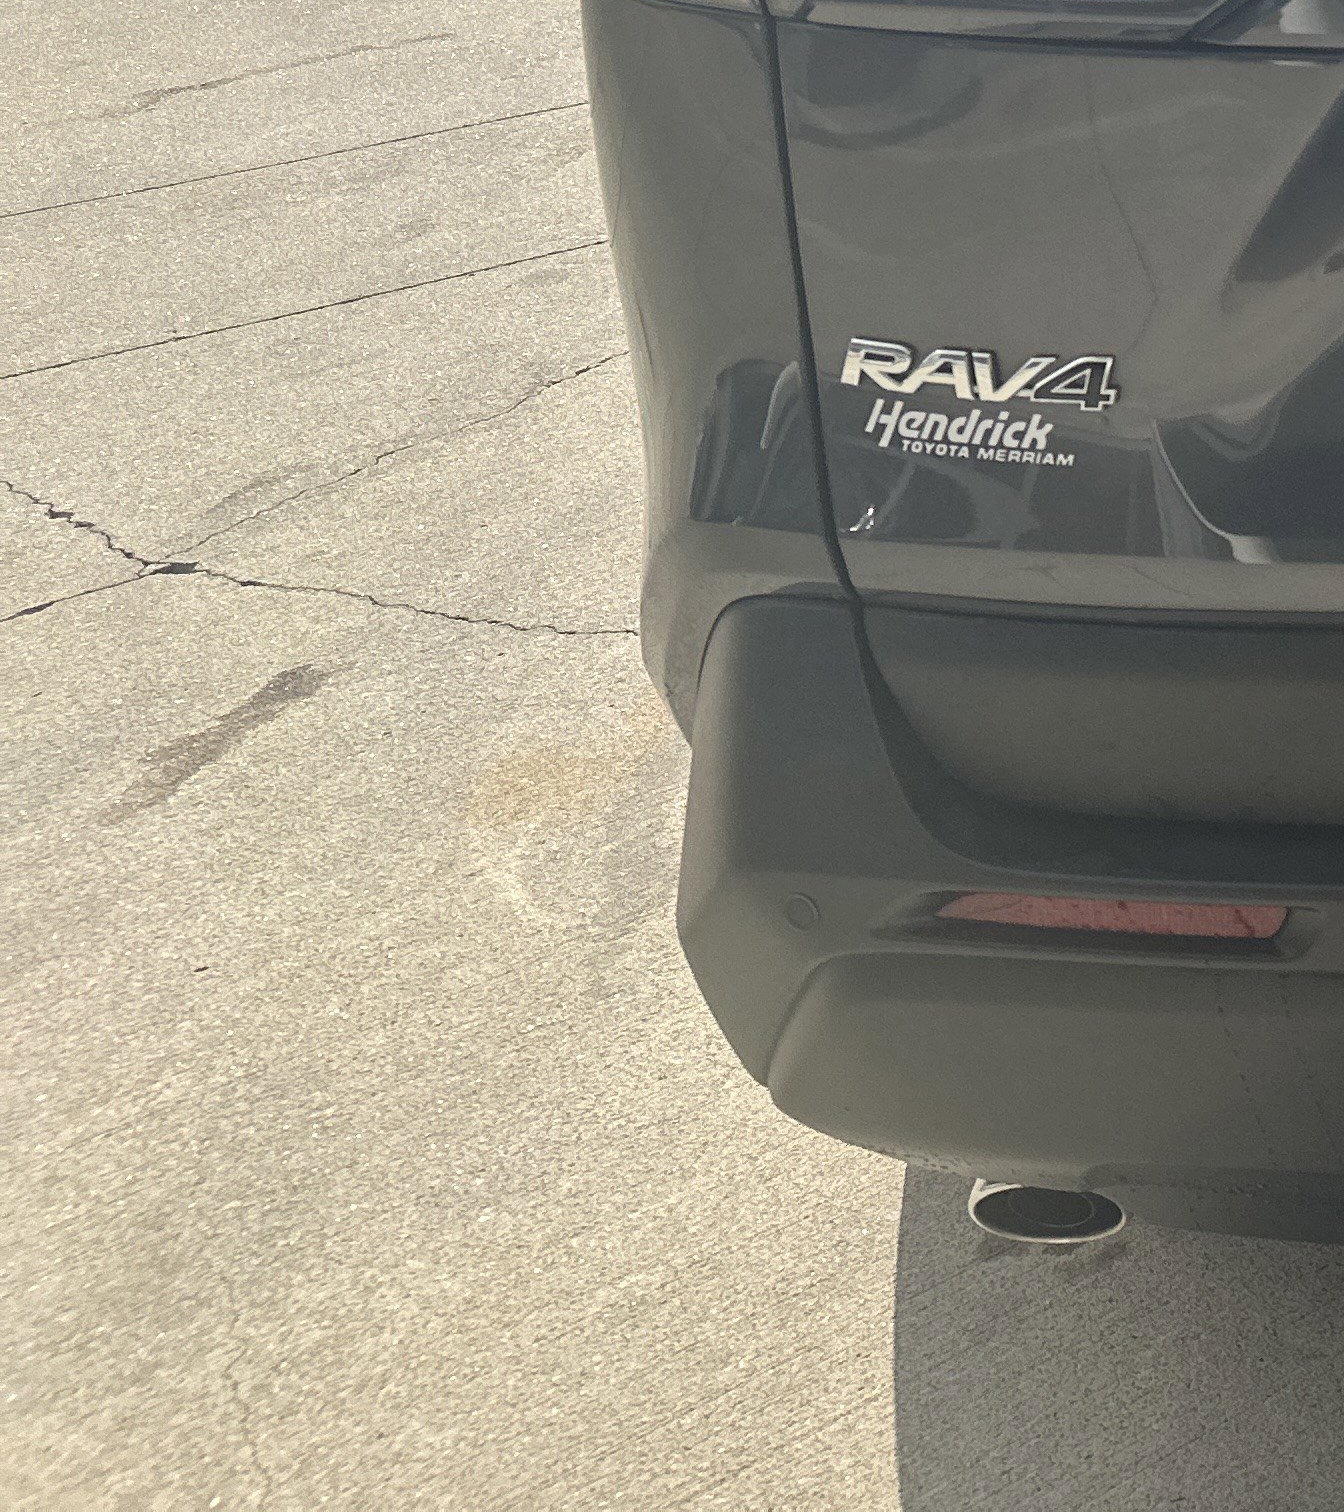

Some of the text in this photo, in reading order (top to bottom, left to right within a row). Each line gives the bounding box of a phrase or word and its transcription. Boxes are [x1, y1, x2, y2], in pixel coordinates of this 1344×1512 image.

[841, 338, 1116, 411] RAV4
[864, 398, 1054, 450] Hendrick
[902, 440, 1075, 466] TOYOTA MERRIAM
